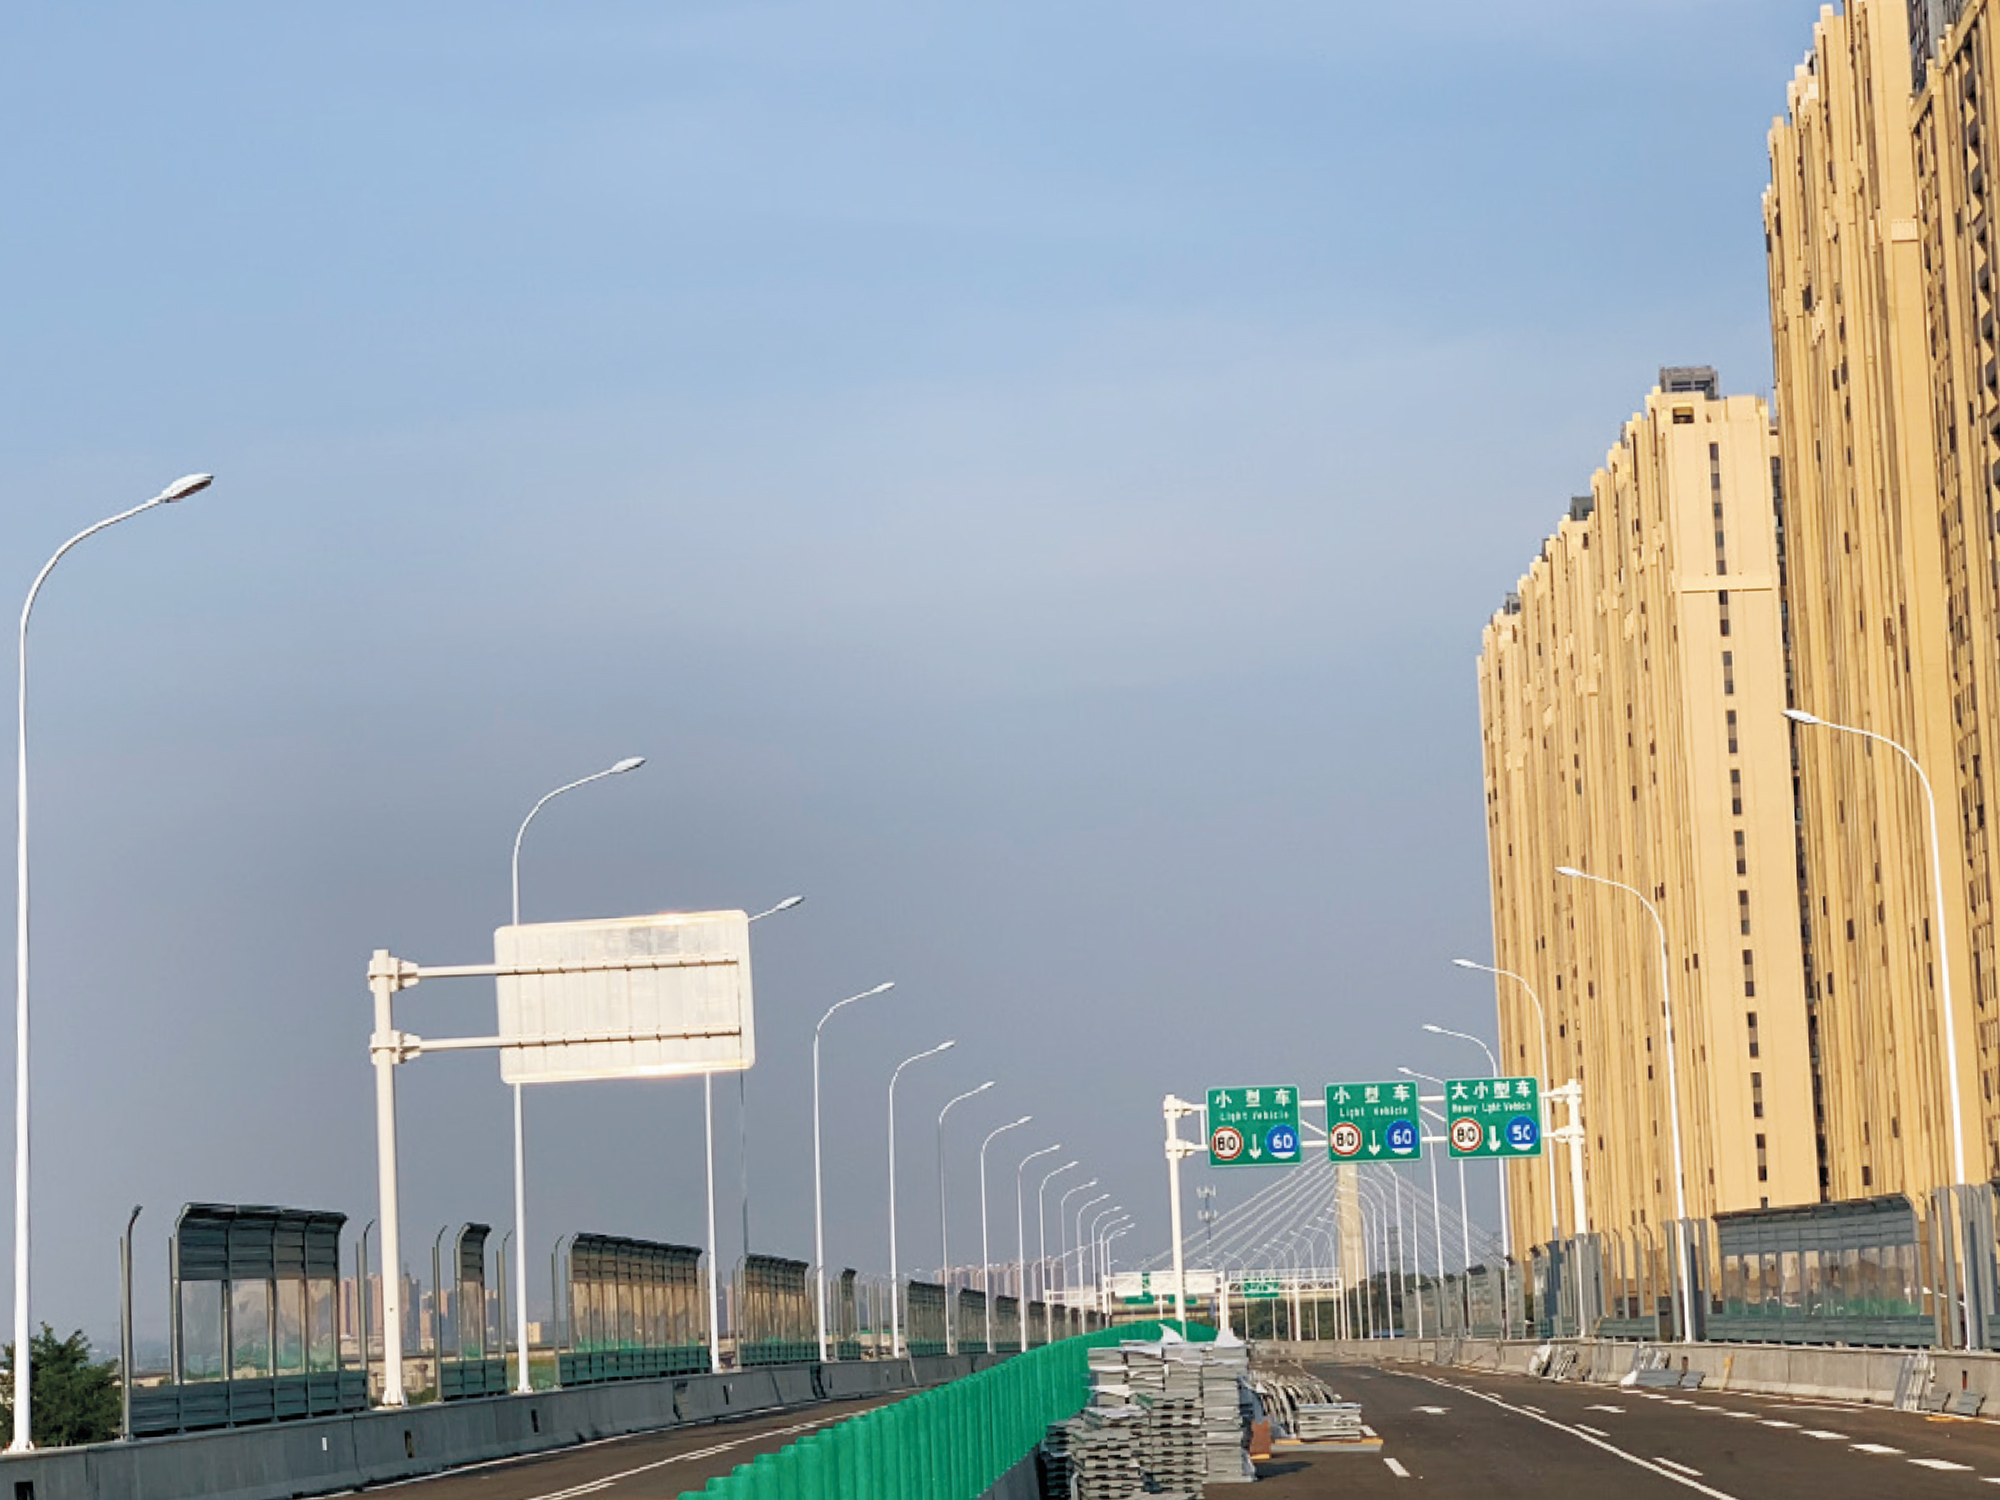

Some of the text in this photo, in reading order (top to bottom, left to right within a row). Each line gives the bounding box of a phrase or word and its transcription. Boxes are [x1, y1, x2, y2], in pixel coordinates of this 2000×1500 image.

[1333, 1084, 1410, 1105] 小型车
[1451, 1080, 1532, 1100] 大小型车
[1214, 1088, 1291, 1109] 小型车
[1219, 1110, 1248, 1123] Light
[1339, 1107, 1365, 1120] Light
[1336, 1131, 1355, 1147] 80
[1393, 1129, 1412, 1145] 60
[1456, 1127, 1476, 1143] 80
[1512, 1124, 1532, 1141] 50
[1217, 1136, 1237, 1151] 80
[1273, 1133, 1294, 1149] 60
